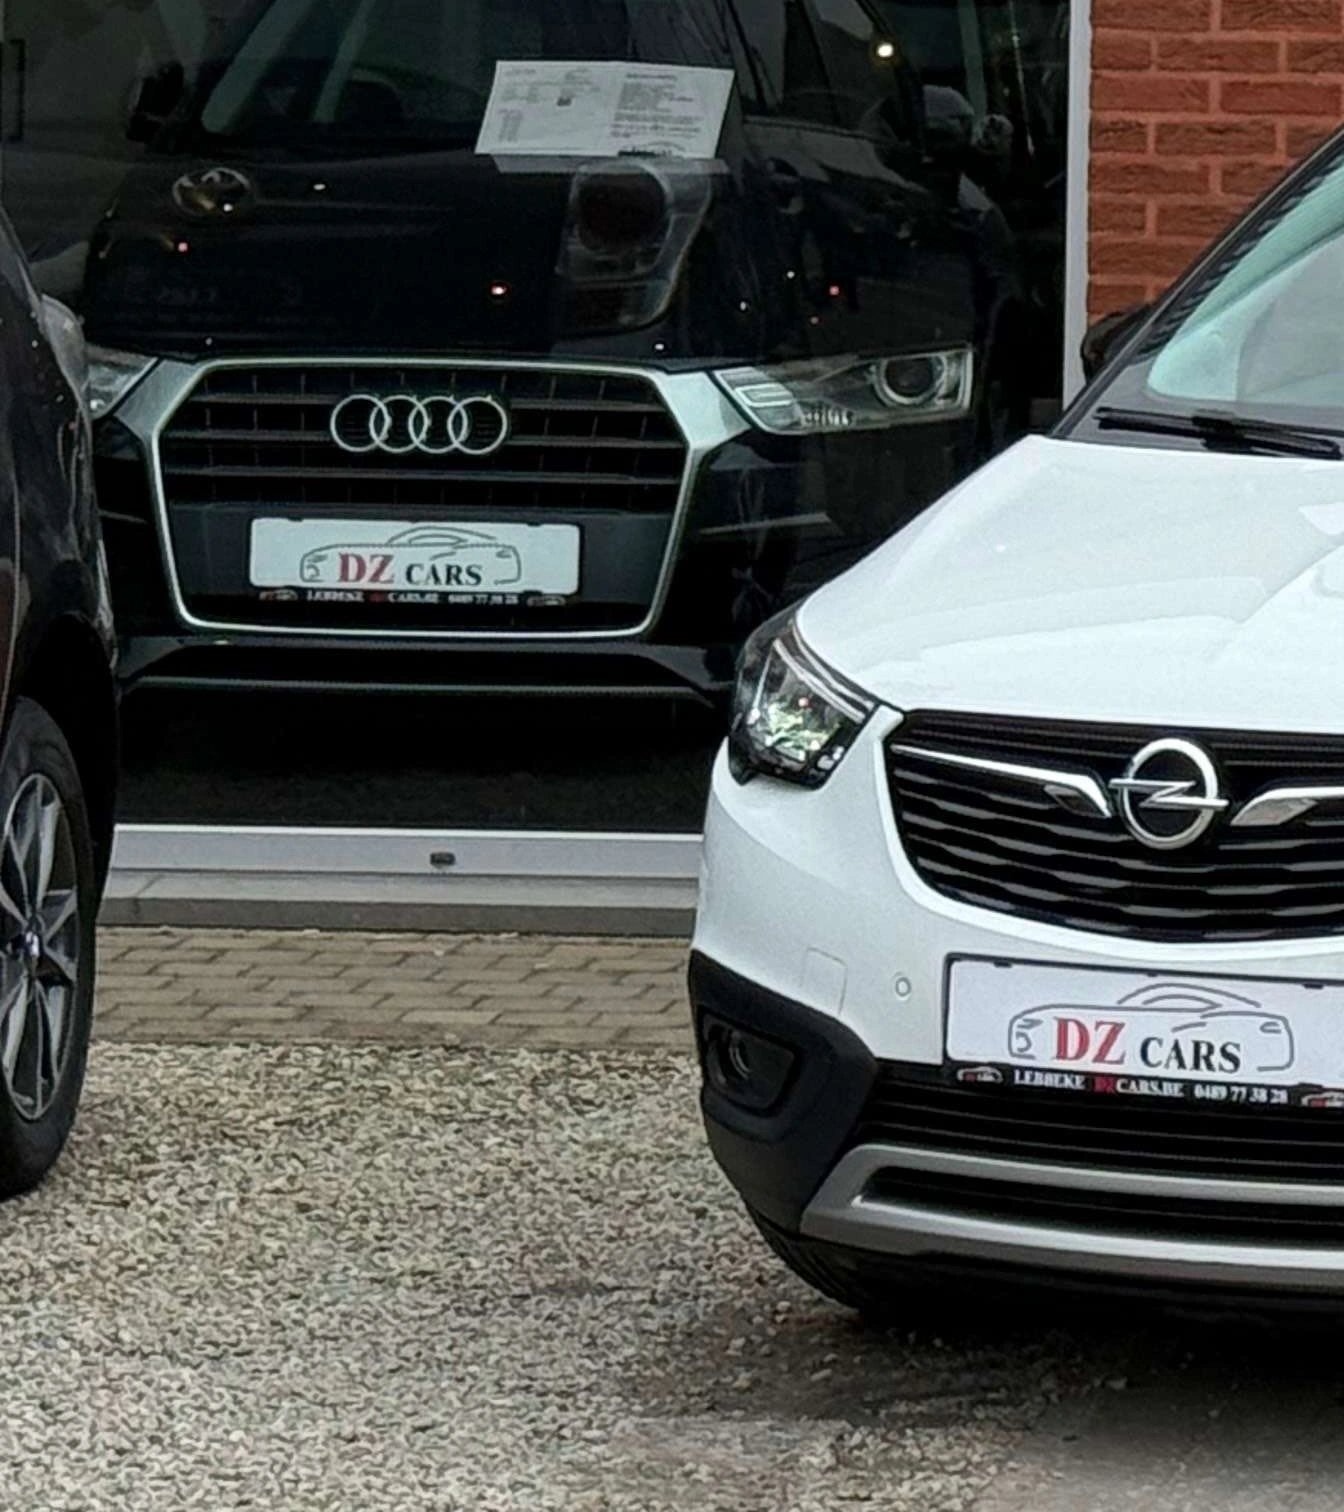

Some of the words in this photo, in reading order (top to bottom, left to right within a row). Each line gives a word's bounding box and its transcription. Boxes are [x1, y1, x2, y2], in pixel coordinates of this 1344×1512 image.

[337, 552, 396, 584] DZ
[405, 563, 483, 587] CARS
[1053, 1017, 1127, 1065] DZ
[1139, 1036, 1242, 1073] CARS
